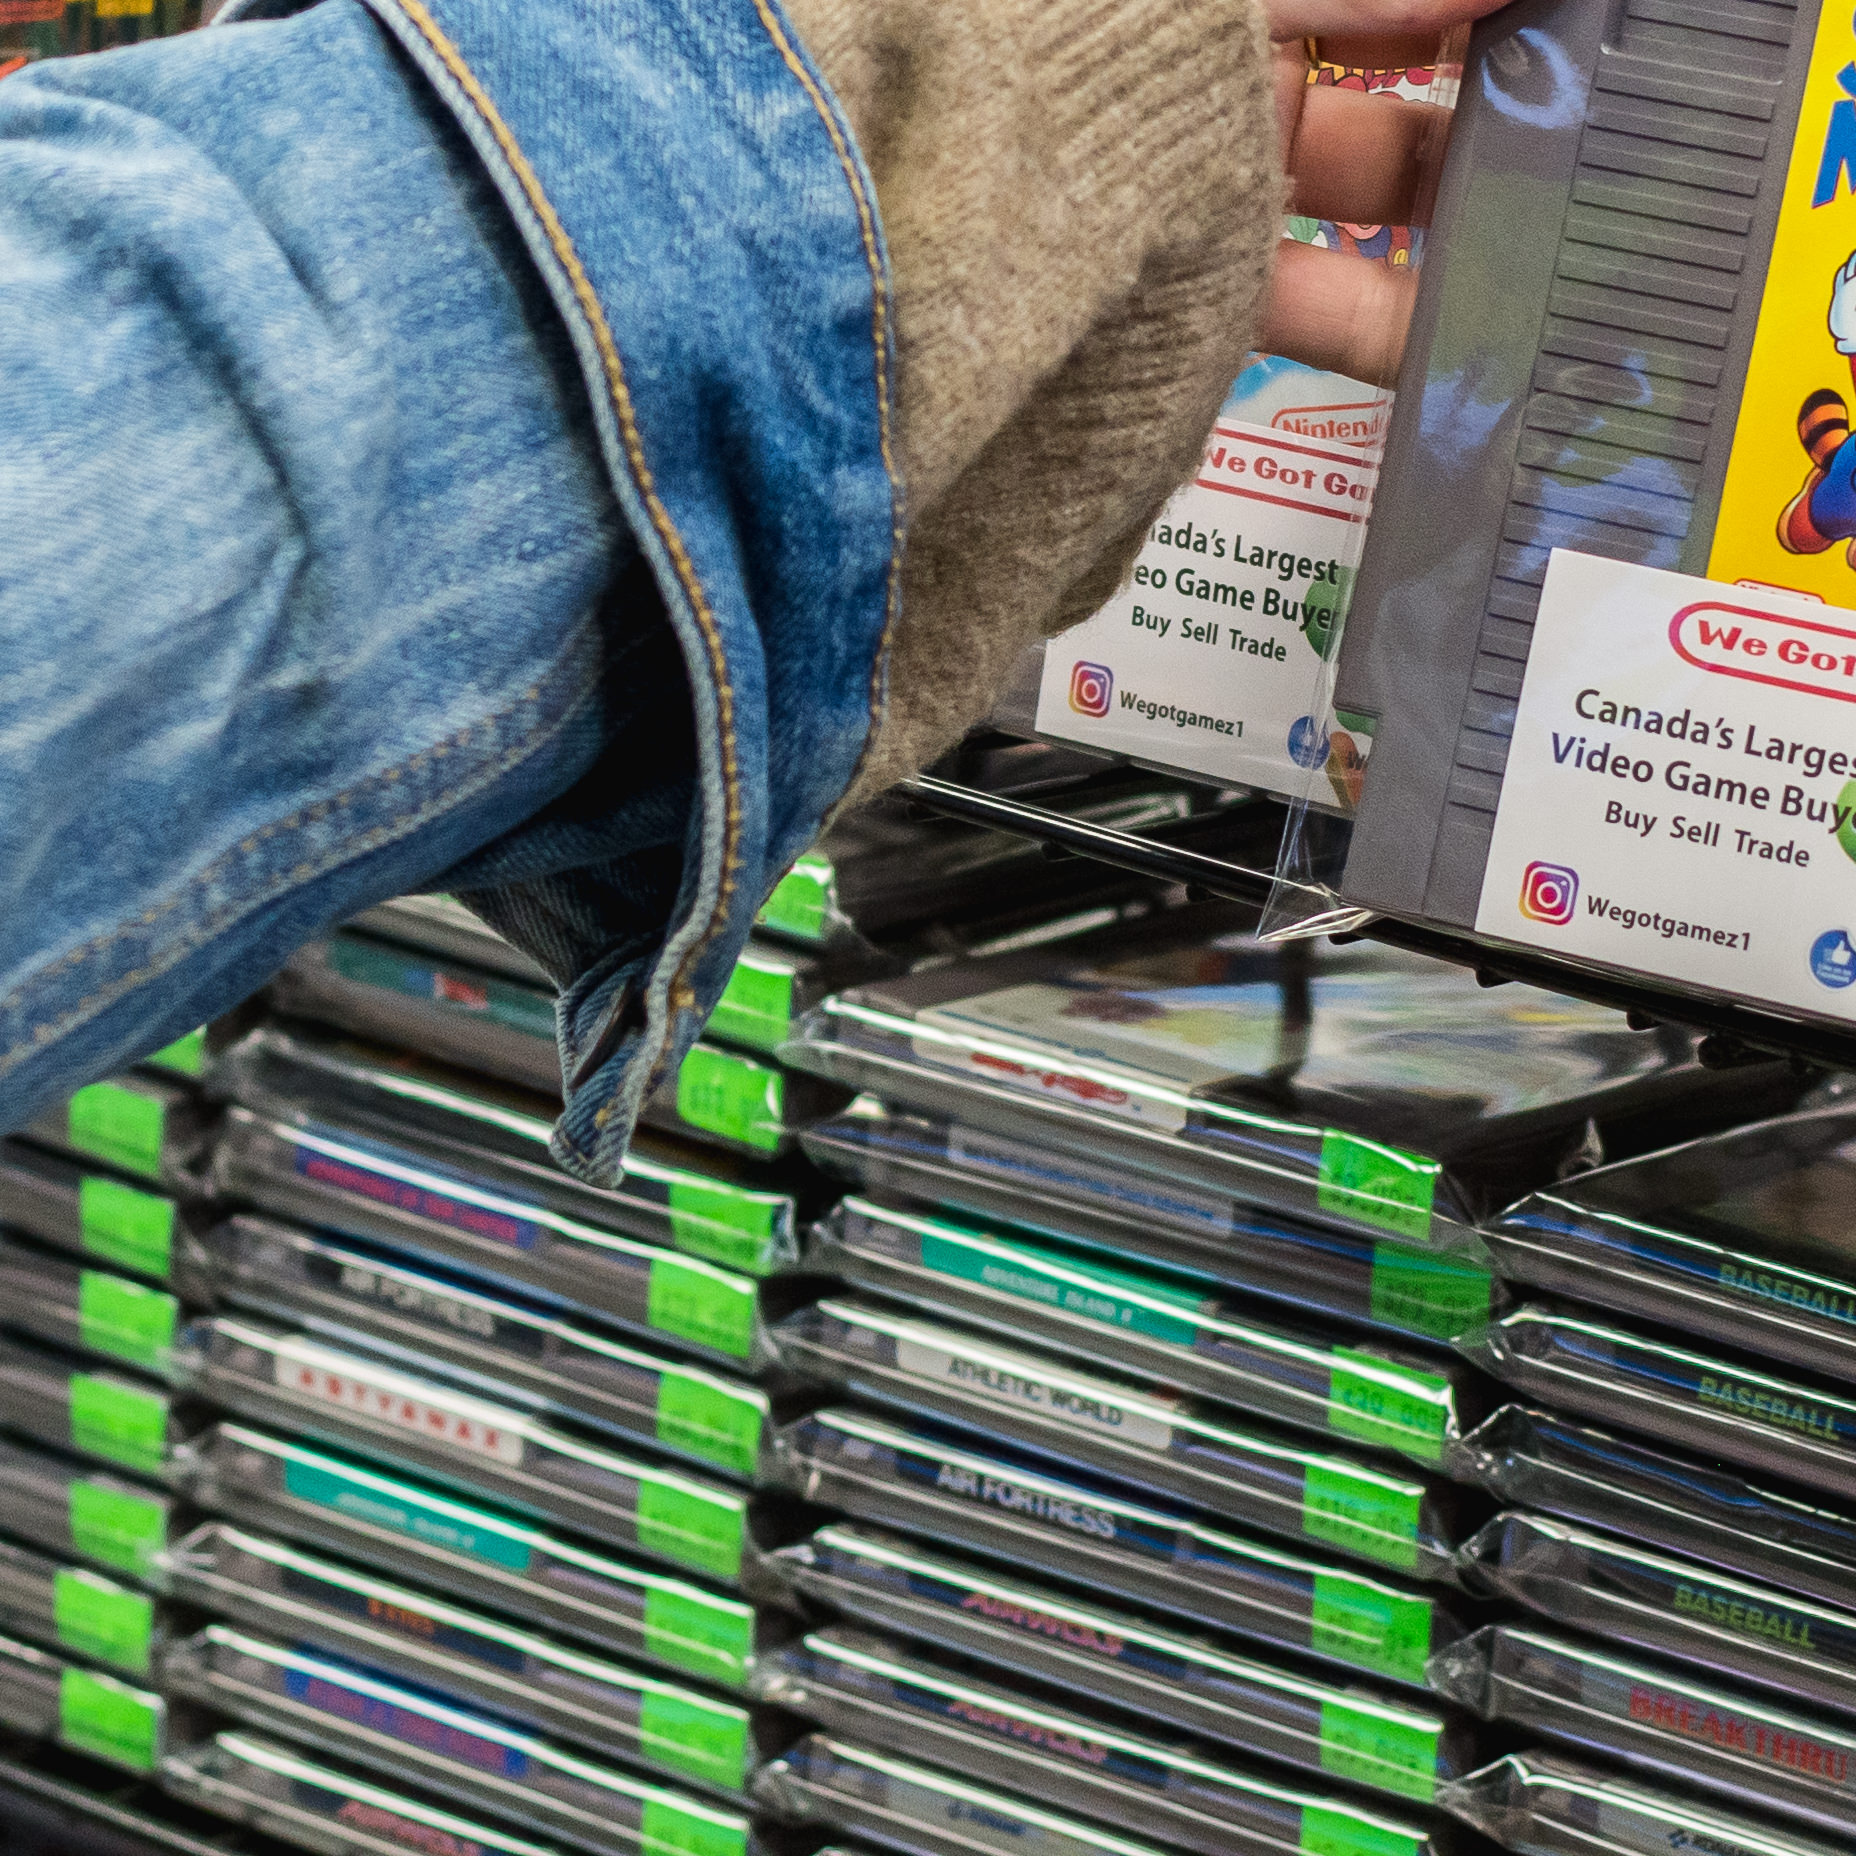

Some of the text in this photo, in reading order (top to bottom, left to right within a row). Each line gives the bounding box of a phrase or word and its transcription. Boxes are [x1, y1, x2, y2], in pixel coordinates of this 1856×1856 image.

[1253, 456, 1317, 490] Got
[1174, 568, 1256, 611] Game
[1233, 535, 1340, 586] Largest
[1130, 606, 1288, 663] Buy Sell Trade
[1696, 619, 1768, 656] We
[1118, 690, 1246, 740] Wegotgamez1
[1574, 688, 1736, 751] Canada's
[1550, 733, 1655, 783] Video
[1664, 760, 1771, 813] Game
[1604, 800, 1812, 869] Buy Sell Trade
[1585, 894, 1753, 952] Wegotgamez1
[948, 1355, 1124, 1426] ATHLETIC WORLD
[1698, 1375, 1840, 1442] BASEBALL
[981, 1475, 1116, 1539] FORTRESS
[1674, 1582, 1815, 1651] BASEBALL
[1629, 1685, 1848, 1783] BREAKTHRU
